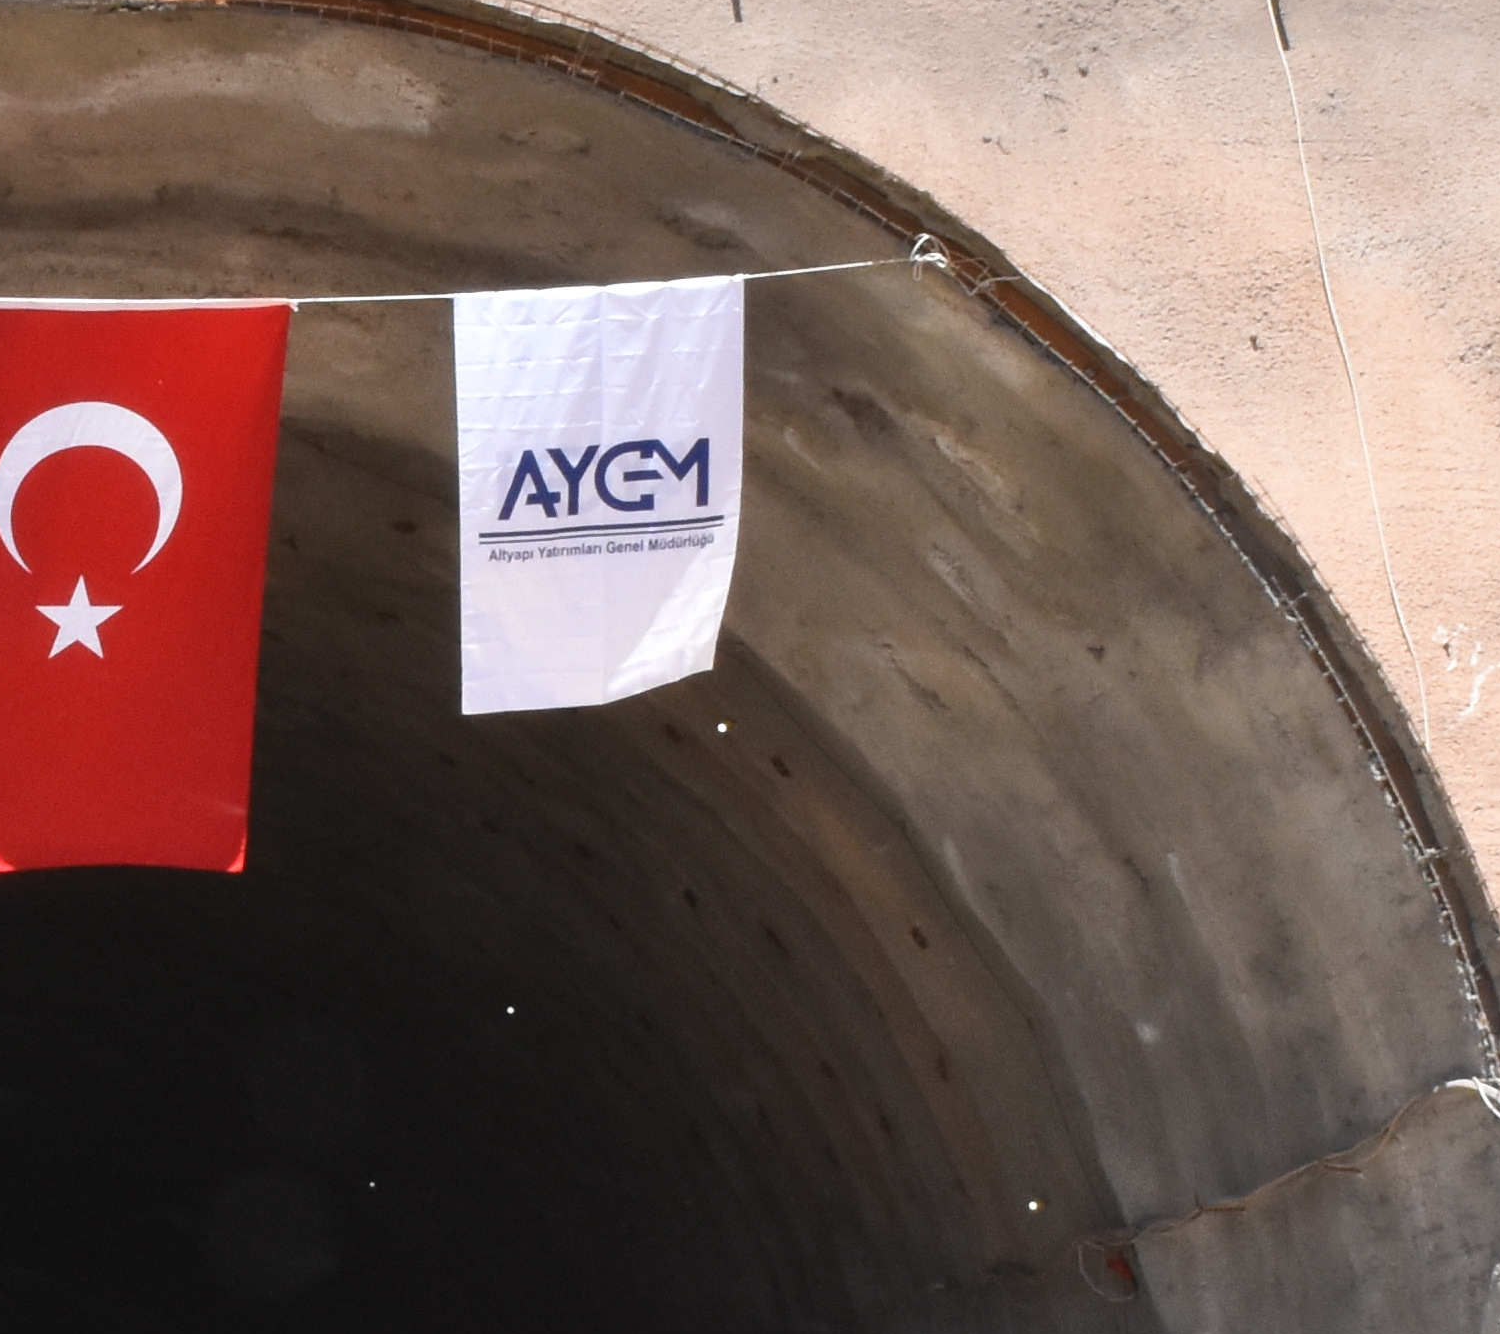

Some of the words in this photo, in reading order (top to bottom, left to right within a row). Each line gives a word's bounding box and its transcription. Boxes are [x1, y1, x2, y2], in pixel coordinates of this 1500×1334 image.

[498, 438, 709, 520] AYGM
[489, 547, 534, 562] Altyapı
[538, 543, 600, 559] Yatırımları
[606, 539, 644, 554] Genel
[648, 532, 714, 550] Müdürlüğü
